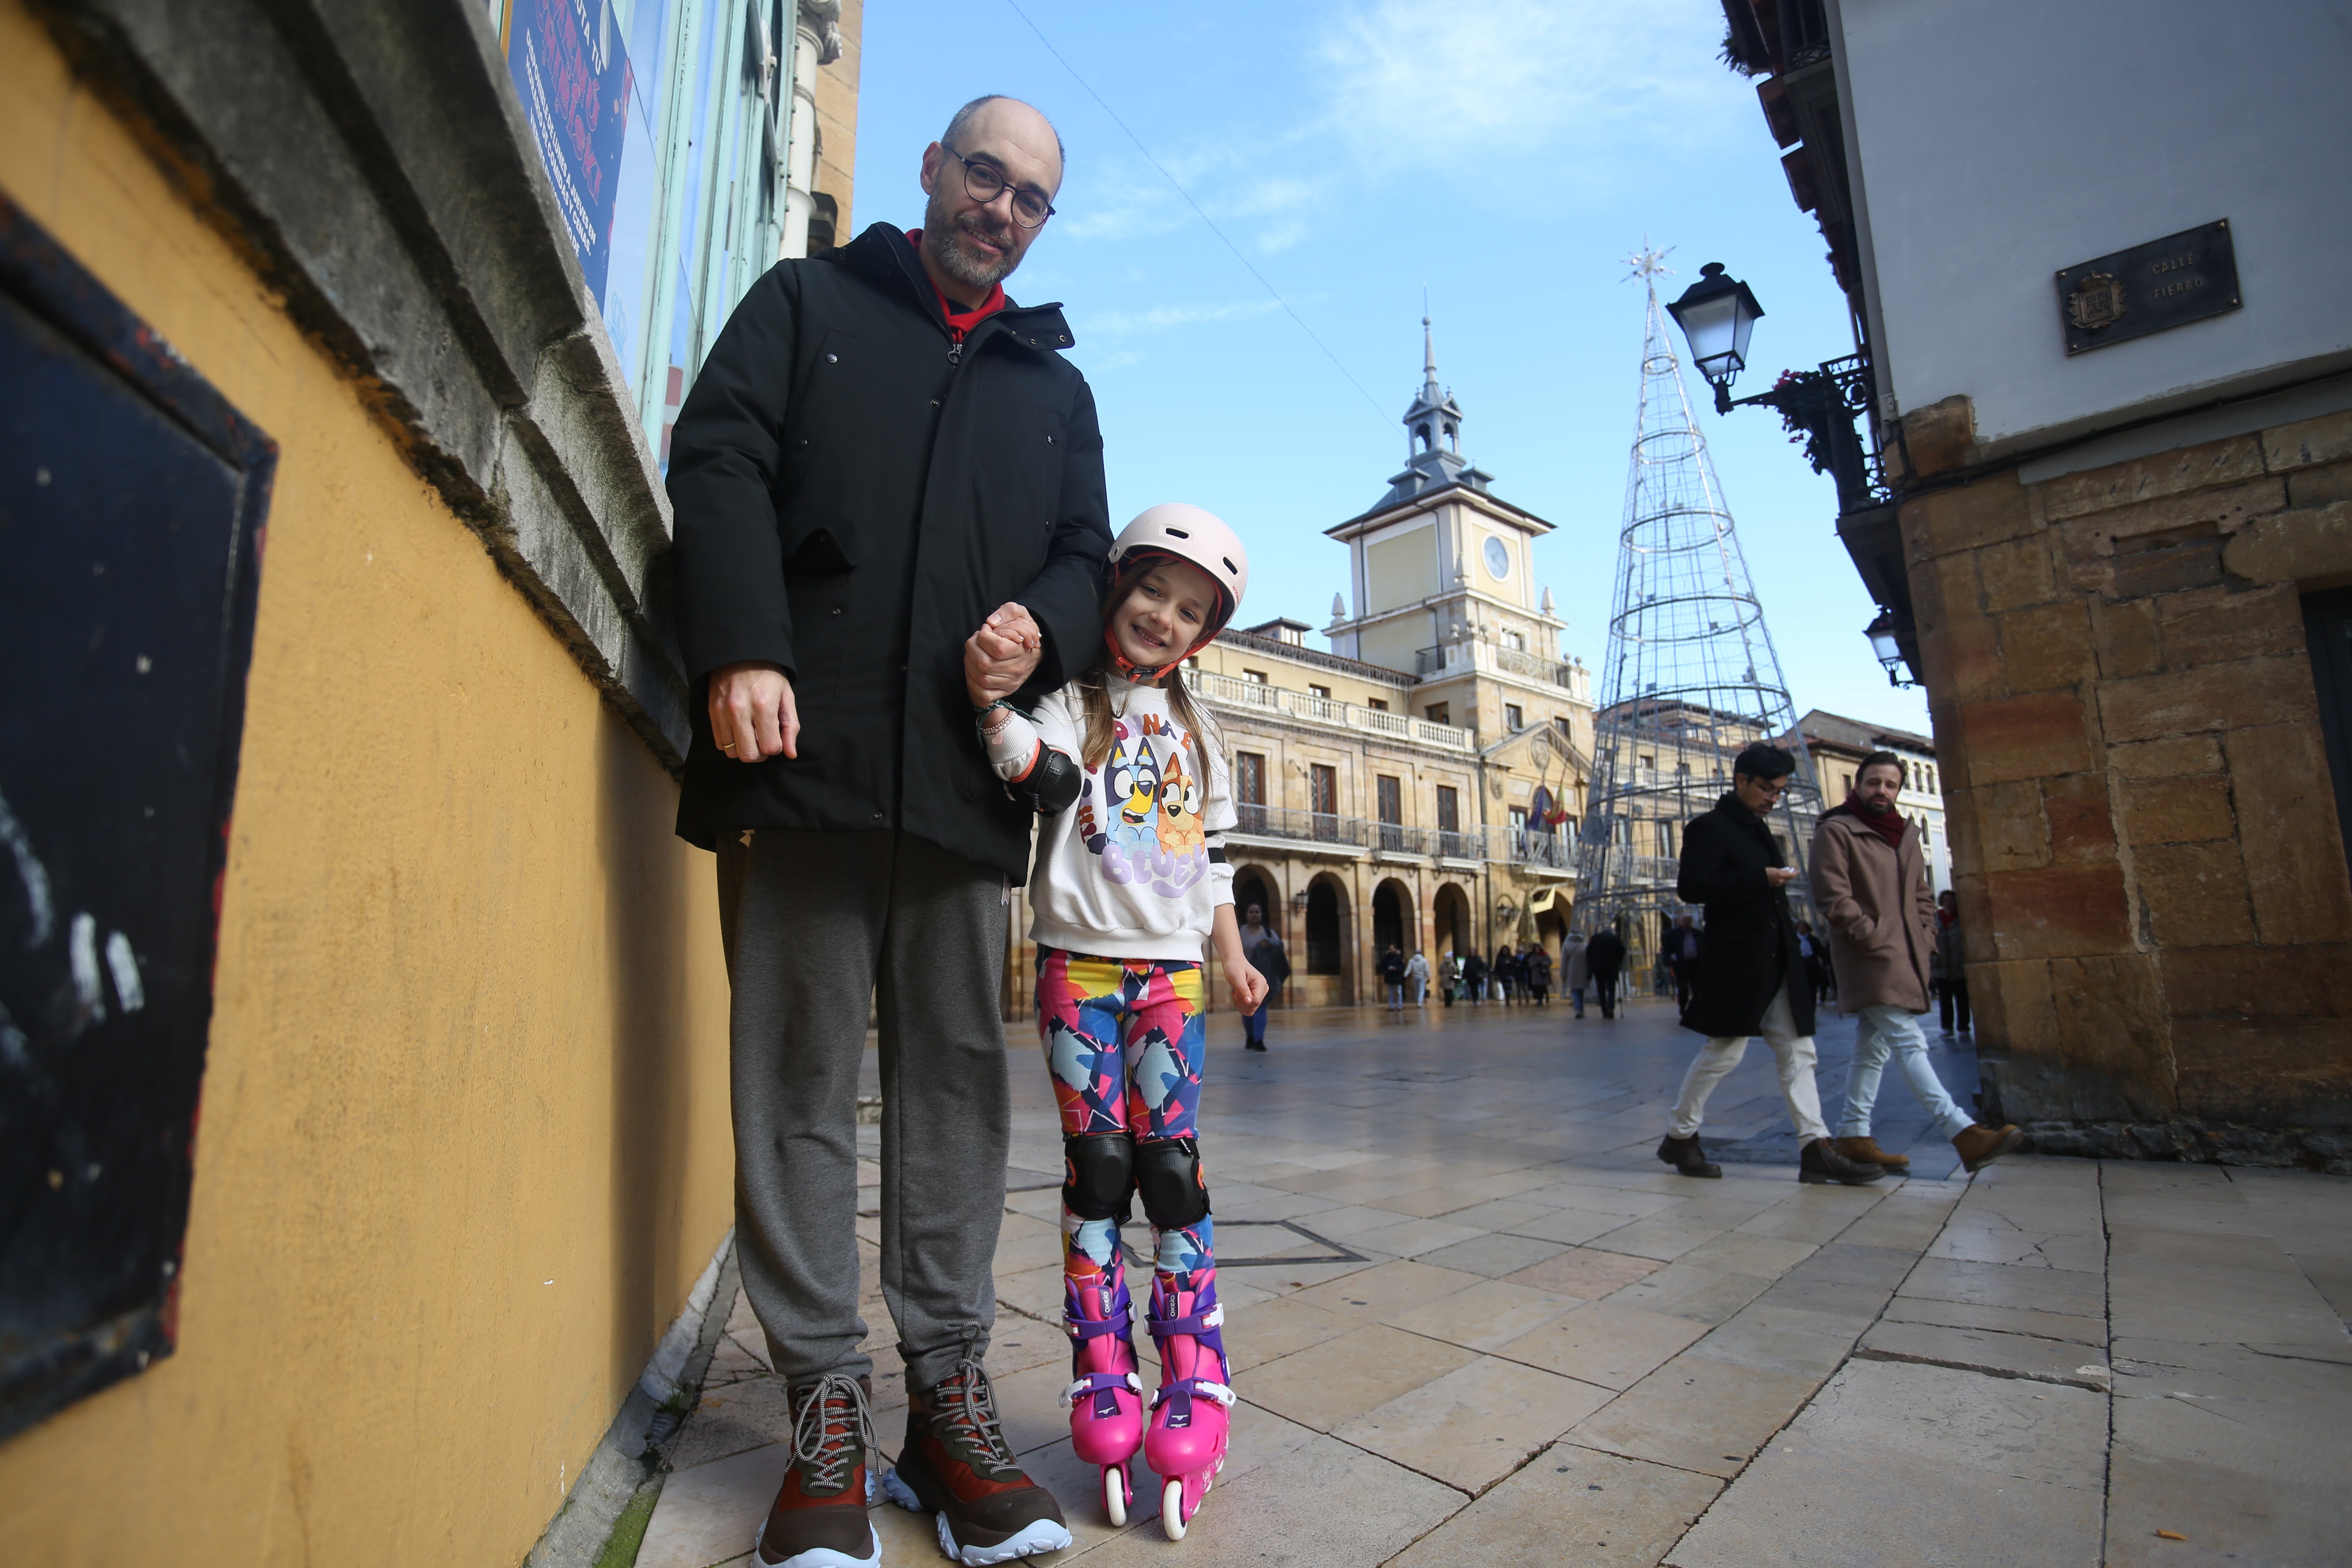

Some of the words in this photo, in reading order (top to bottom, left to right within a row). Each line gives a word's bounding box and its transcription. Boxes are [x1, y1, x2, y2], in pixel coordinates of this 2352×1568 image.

[592, 39, 601, 76] TU
[526, 27, 549, 121] DISPONIBLE
[547, 113, 554, 139] DE
[552, 131, 568, 177] LUNES
[566, 173, 571, 189] A
[570, 184, 589, 229] JUEVES
[588, 223, 596, 245] EN
[526, 54, 543, 127] HORARIO
[542, 122, 548, 148] DE
[548, 142, 569, 206] COMIDAS
[569, 198, 573, 214] Y
[573, 210, 591, 256] CENAS.
[572, 235, 580, 257] DE
[2152, 254, 2194, 275] CALLE
[2154, 278, 2202, 300] FIERRO
[1114, 713, 1177, 740] ONNA
[1101, 843, 1208, 898] BLUEY
